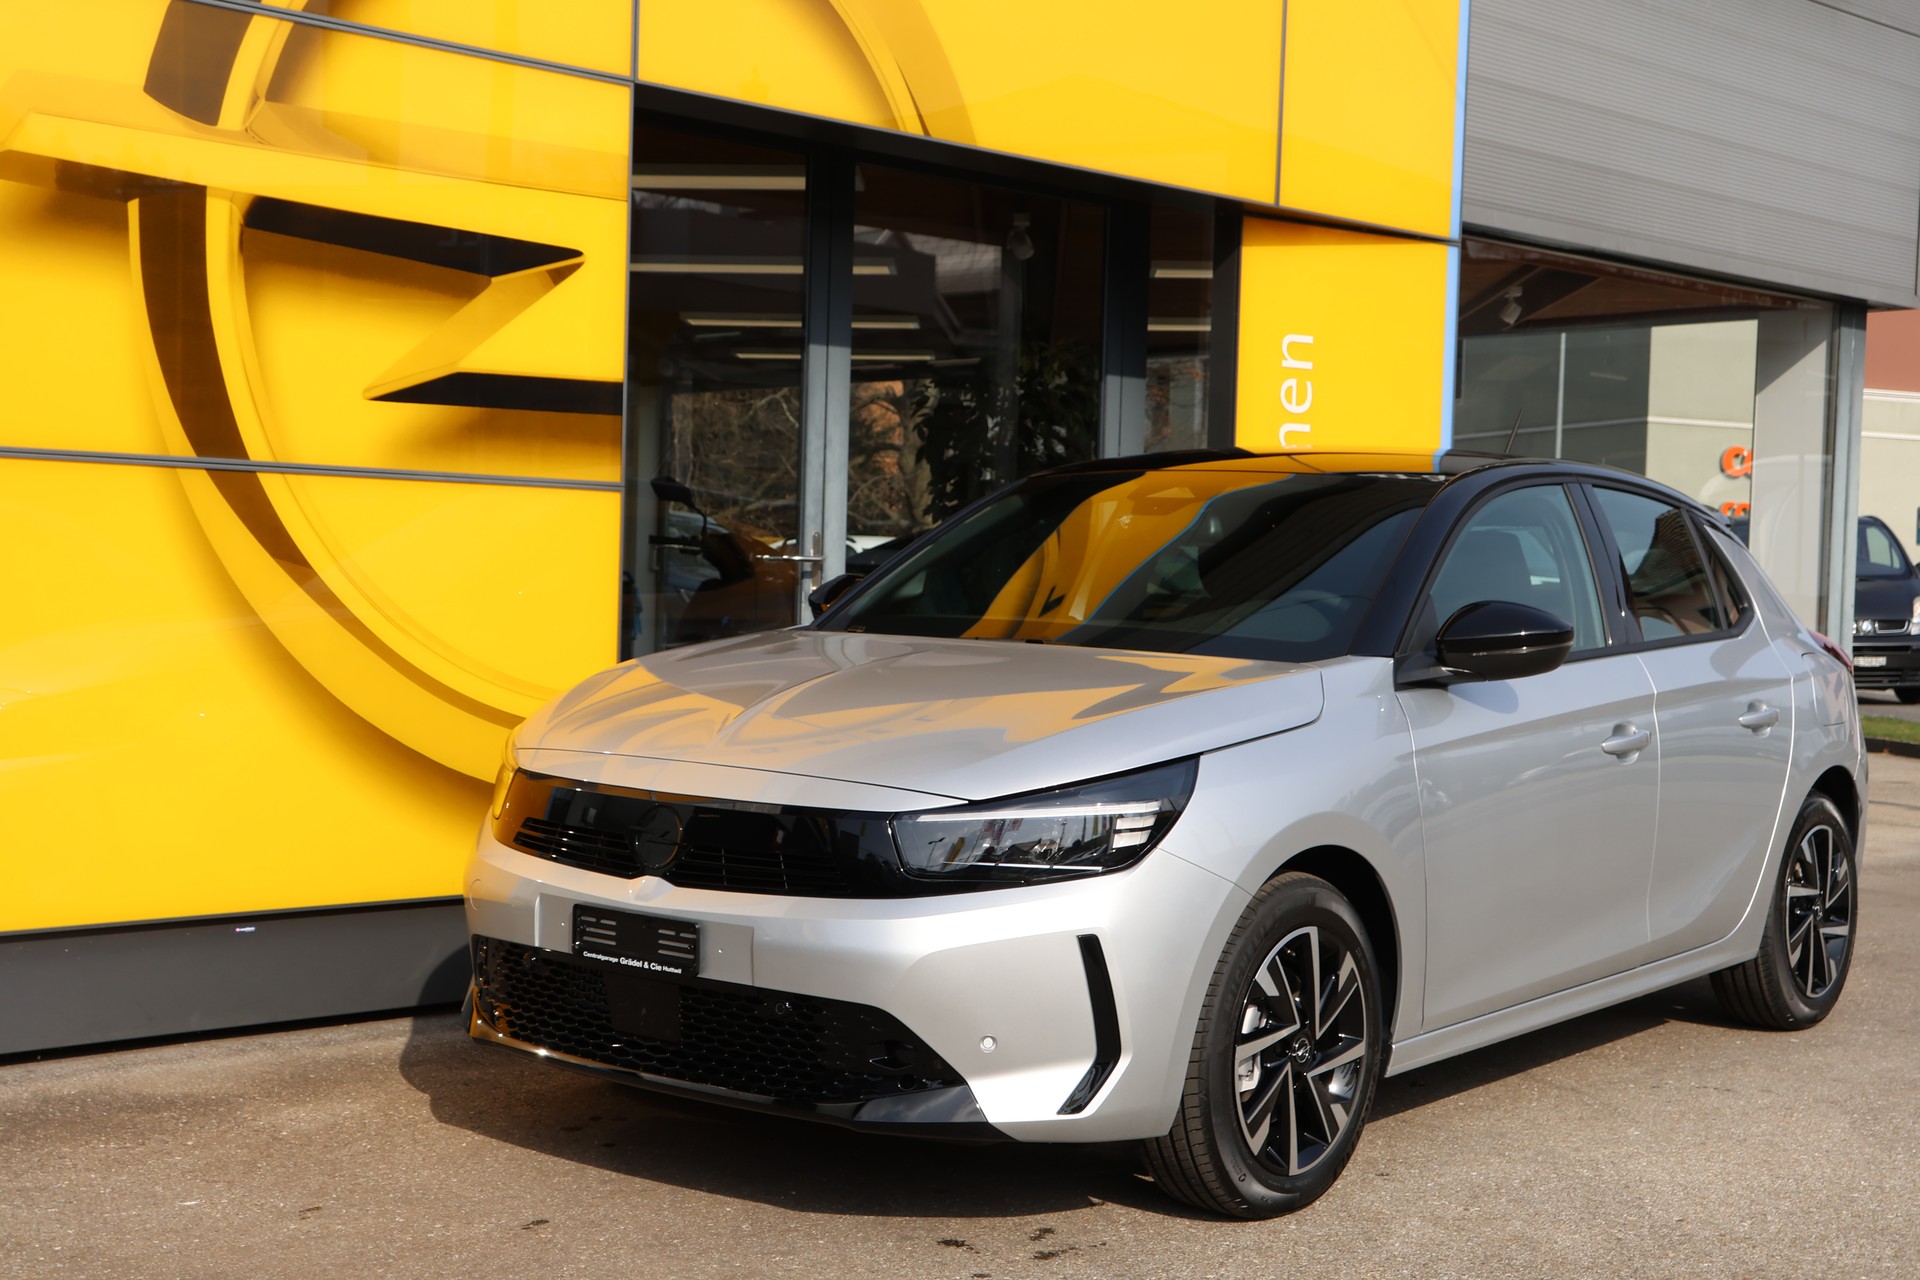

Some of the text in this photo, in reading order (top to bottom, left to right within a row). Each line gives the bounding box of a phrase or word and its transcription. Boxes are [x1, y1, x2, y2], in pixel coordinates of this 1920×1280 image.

[583, 951, 619, 963] Centralgarage
[620, 957, 643, 968] Grädel
[643, 961, 650, 969] &
[650, 962, 662, 972] Cie
